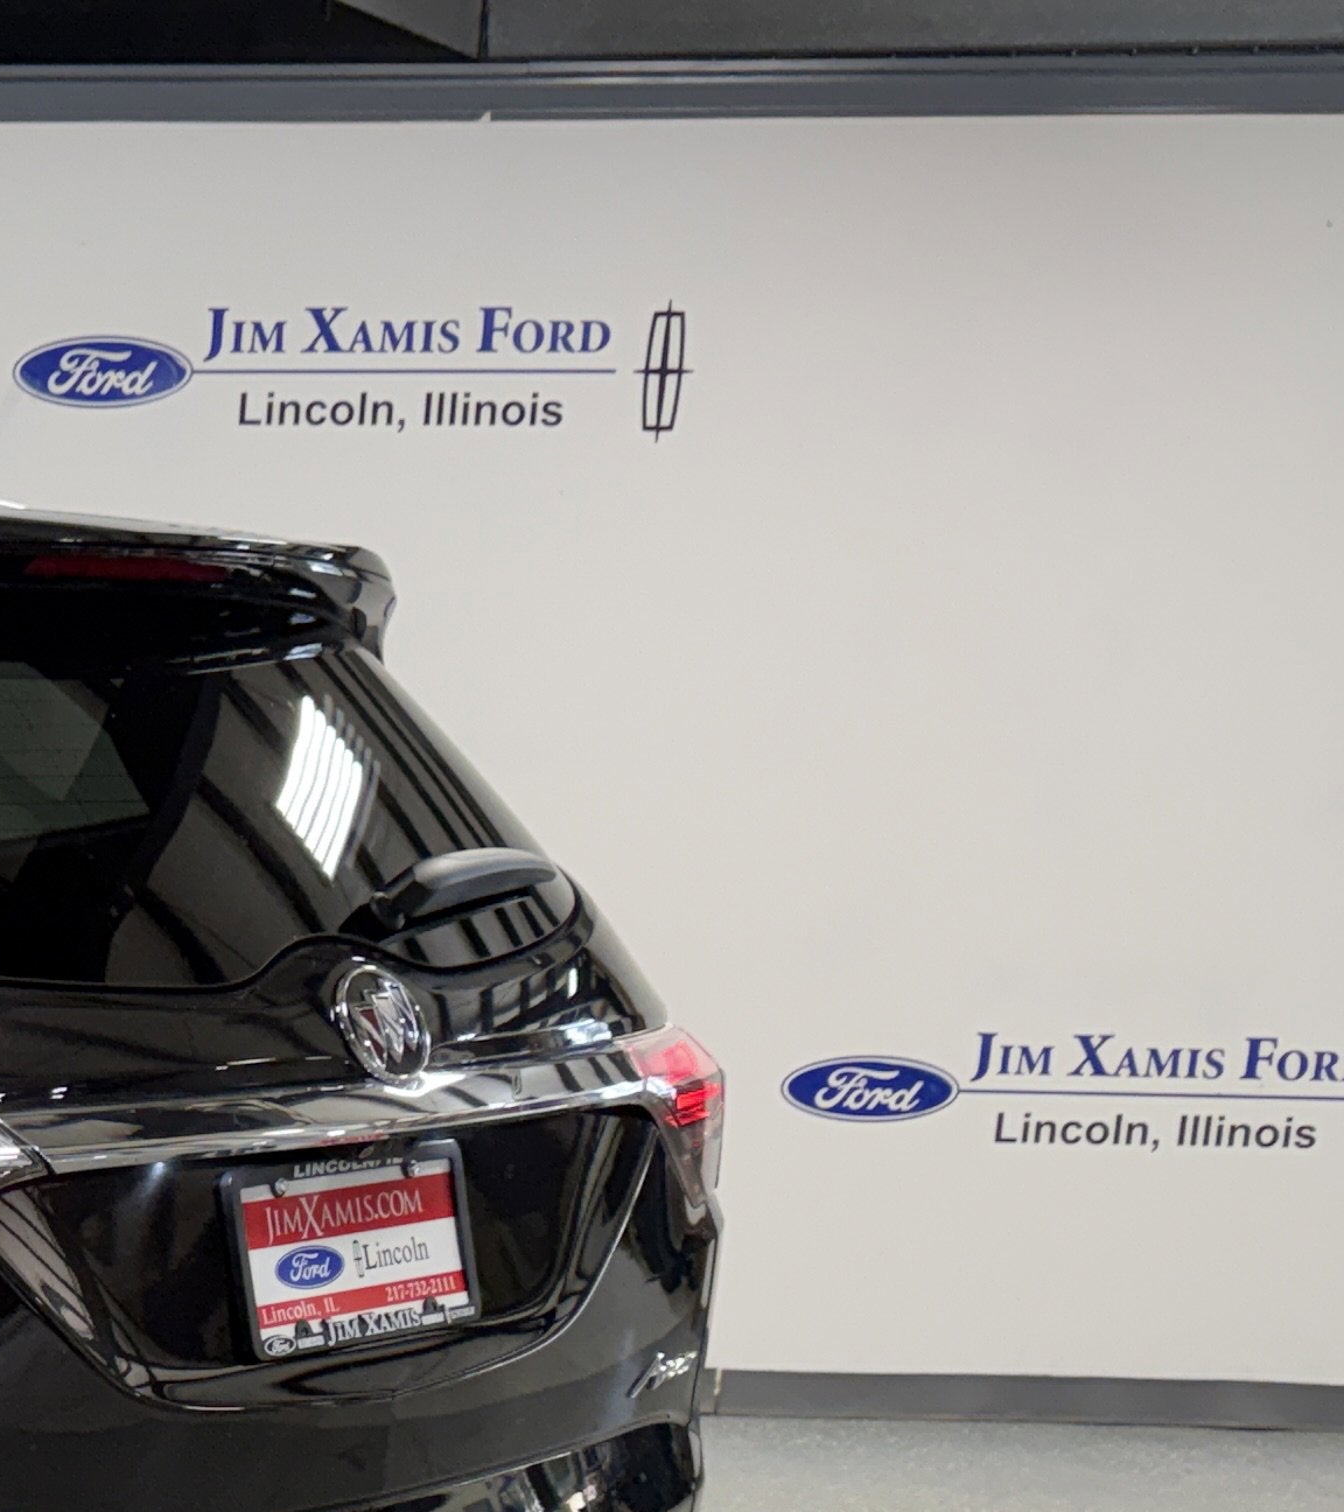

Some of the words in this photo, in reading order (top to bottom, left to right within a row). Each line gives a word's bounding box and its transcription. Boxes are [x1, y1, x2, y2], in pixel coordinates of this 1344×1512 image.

[202, 307, 287, 363] JIM
[300, 306, 460, 354] XAMIS
[476, 306, 612, 354] FORD
[45, 346, 155, 397] Ford
[238, 391, 406, 433] Lincoln,
[422, 391, 563, 427] Illinois
[969, 1031, 1055, 1083] JIM
[1066, 1034, 1225, 1080] XAMIS
[1239, 1037, 1344, 1083] FOR
[813, 1065, 926, 1114] Ford
[993, 1111, 1160, 1153] Lincoln,
[1176, 1114, 1317, 1149] Illinois
[288, 1251, 332, 1282] Ford
[362, 1237, 430, 1270] Lincoln
[385, 1275, 457, 1303] 217-732-2111
[261, 1301, 322, 1326] Lincoln,
[323, 1299, 341, 1315] IL
